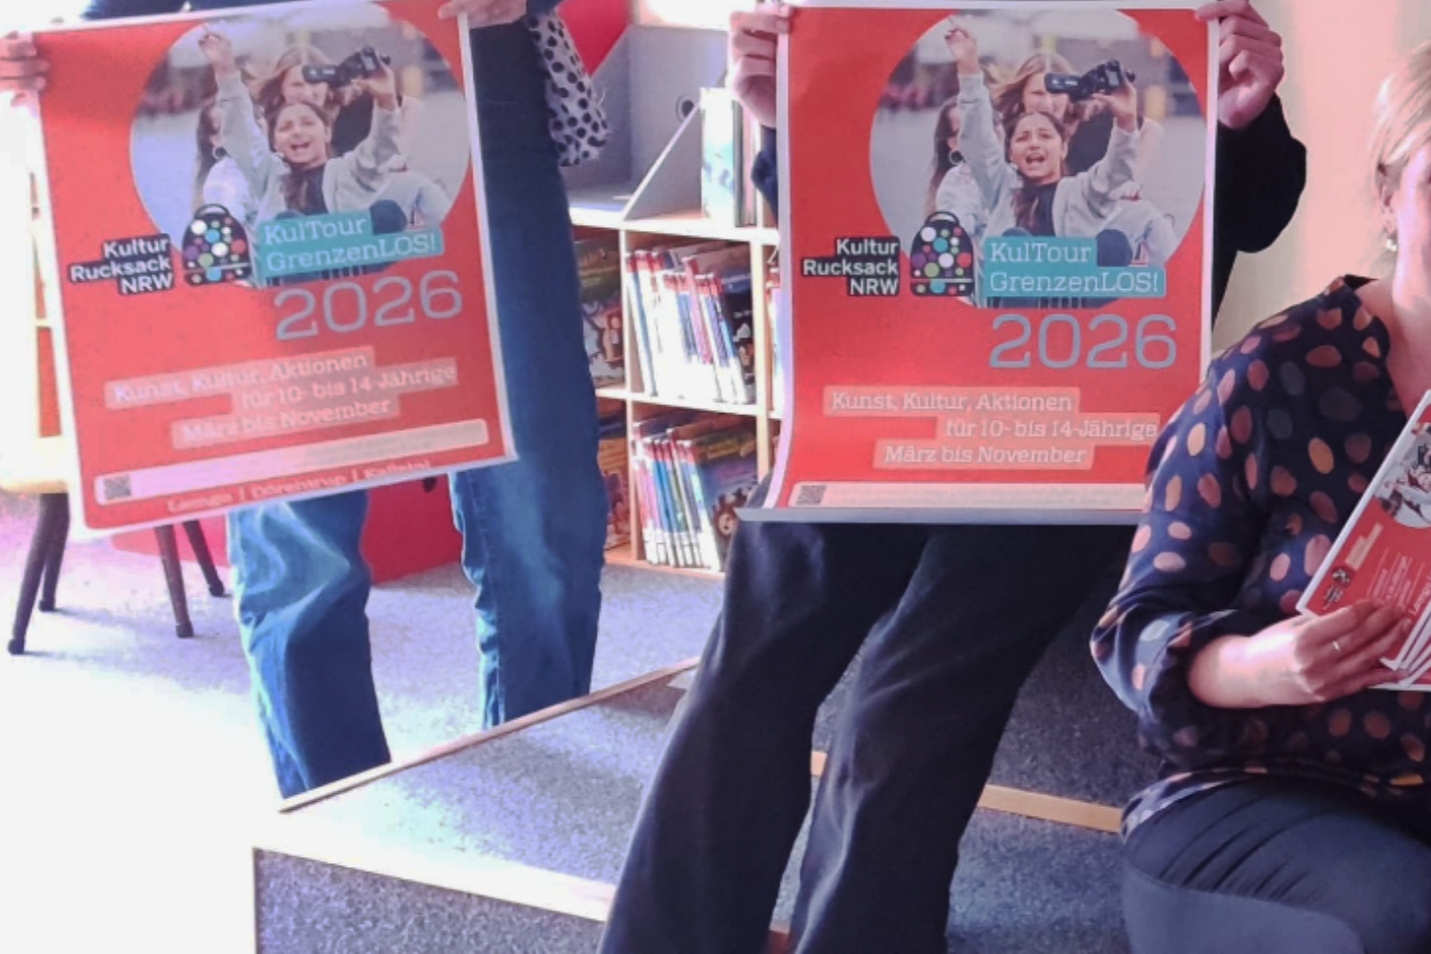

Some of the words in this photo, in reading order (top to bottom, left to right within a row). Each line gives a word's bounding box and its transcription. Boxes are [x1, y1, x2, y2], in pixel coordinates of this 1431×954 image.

[264, 217, 368, 246] KulTour
[103, 237, 169, 260] Kultur
[266, 232, 437, 273] GrenzenLOS!
[835, 238, 899, 257] Kultur
[989, 242, 1092, 264] KulTour
[69, 254, 172, 282] Rucksack
[802, 258, 899, 277] Rucksack
[120, 272, 173, 295] NRW
[849, 277, 899, 296] NRW
[989, 271, 1160, 294] GrenzenLOS!
[273, 269, 463, 341] 2026
[988, 312, 1178, 370] 2026
[269, 353, 369, 381] Aktionen
[311, 380, 347, 399] bis
[279, 398, 392, 430] November
[831, 392, 898, 412] Kunst,
[902, 392, 972, 415] Kultur,
[975, 392, 1074, 413] Aktionen
[945, 418, 977, 438] für
[980, 420, 1010, 438] 10-
[1014, 420, 1048, 438] bis
[1051, 419, 1159, 442] 14-Jährige
[884, 444, 937, 464] März
[941, 444, 973, 464] bis
[977, 444, 1088, 465] November
